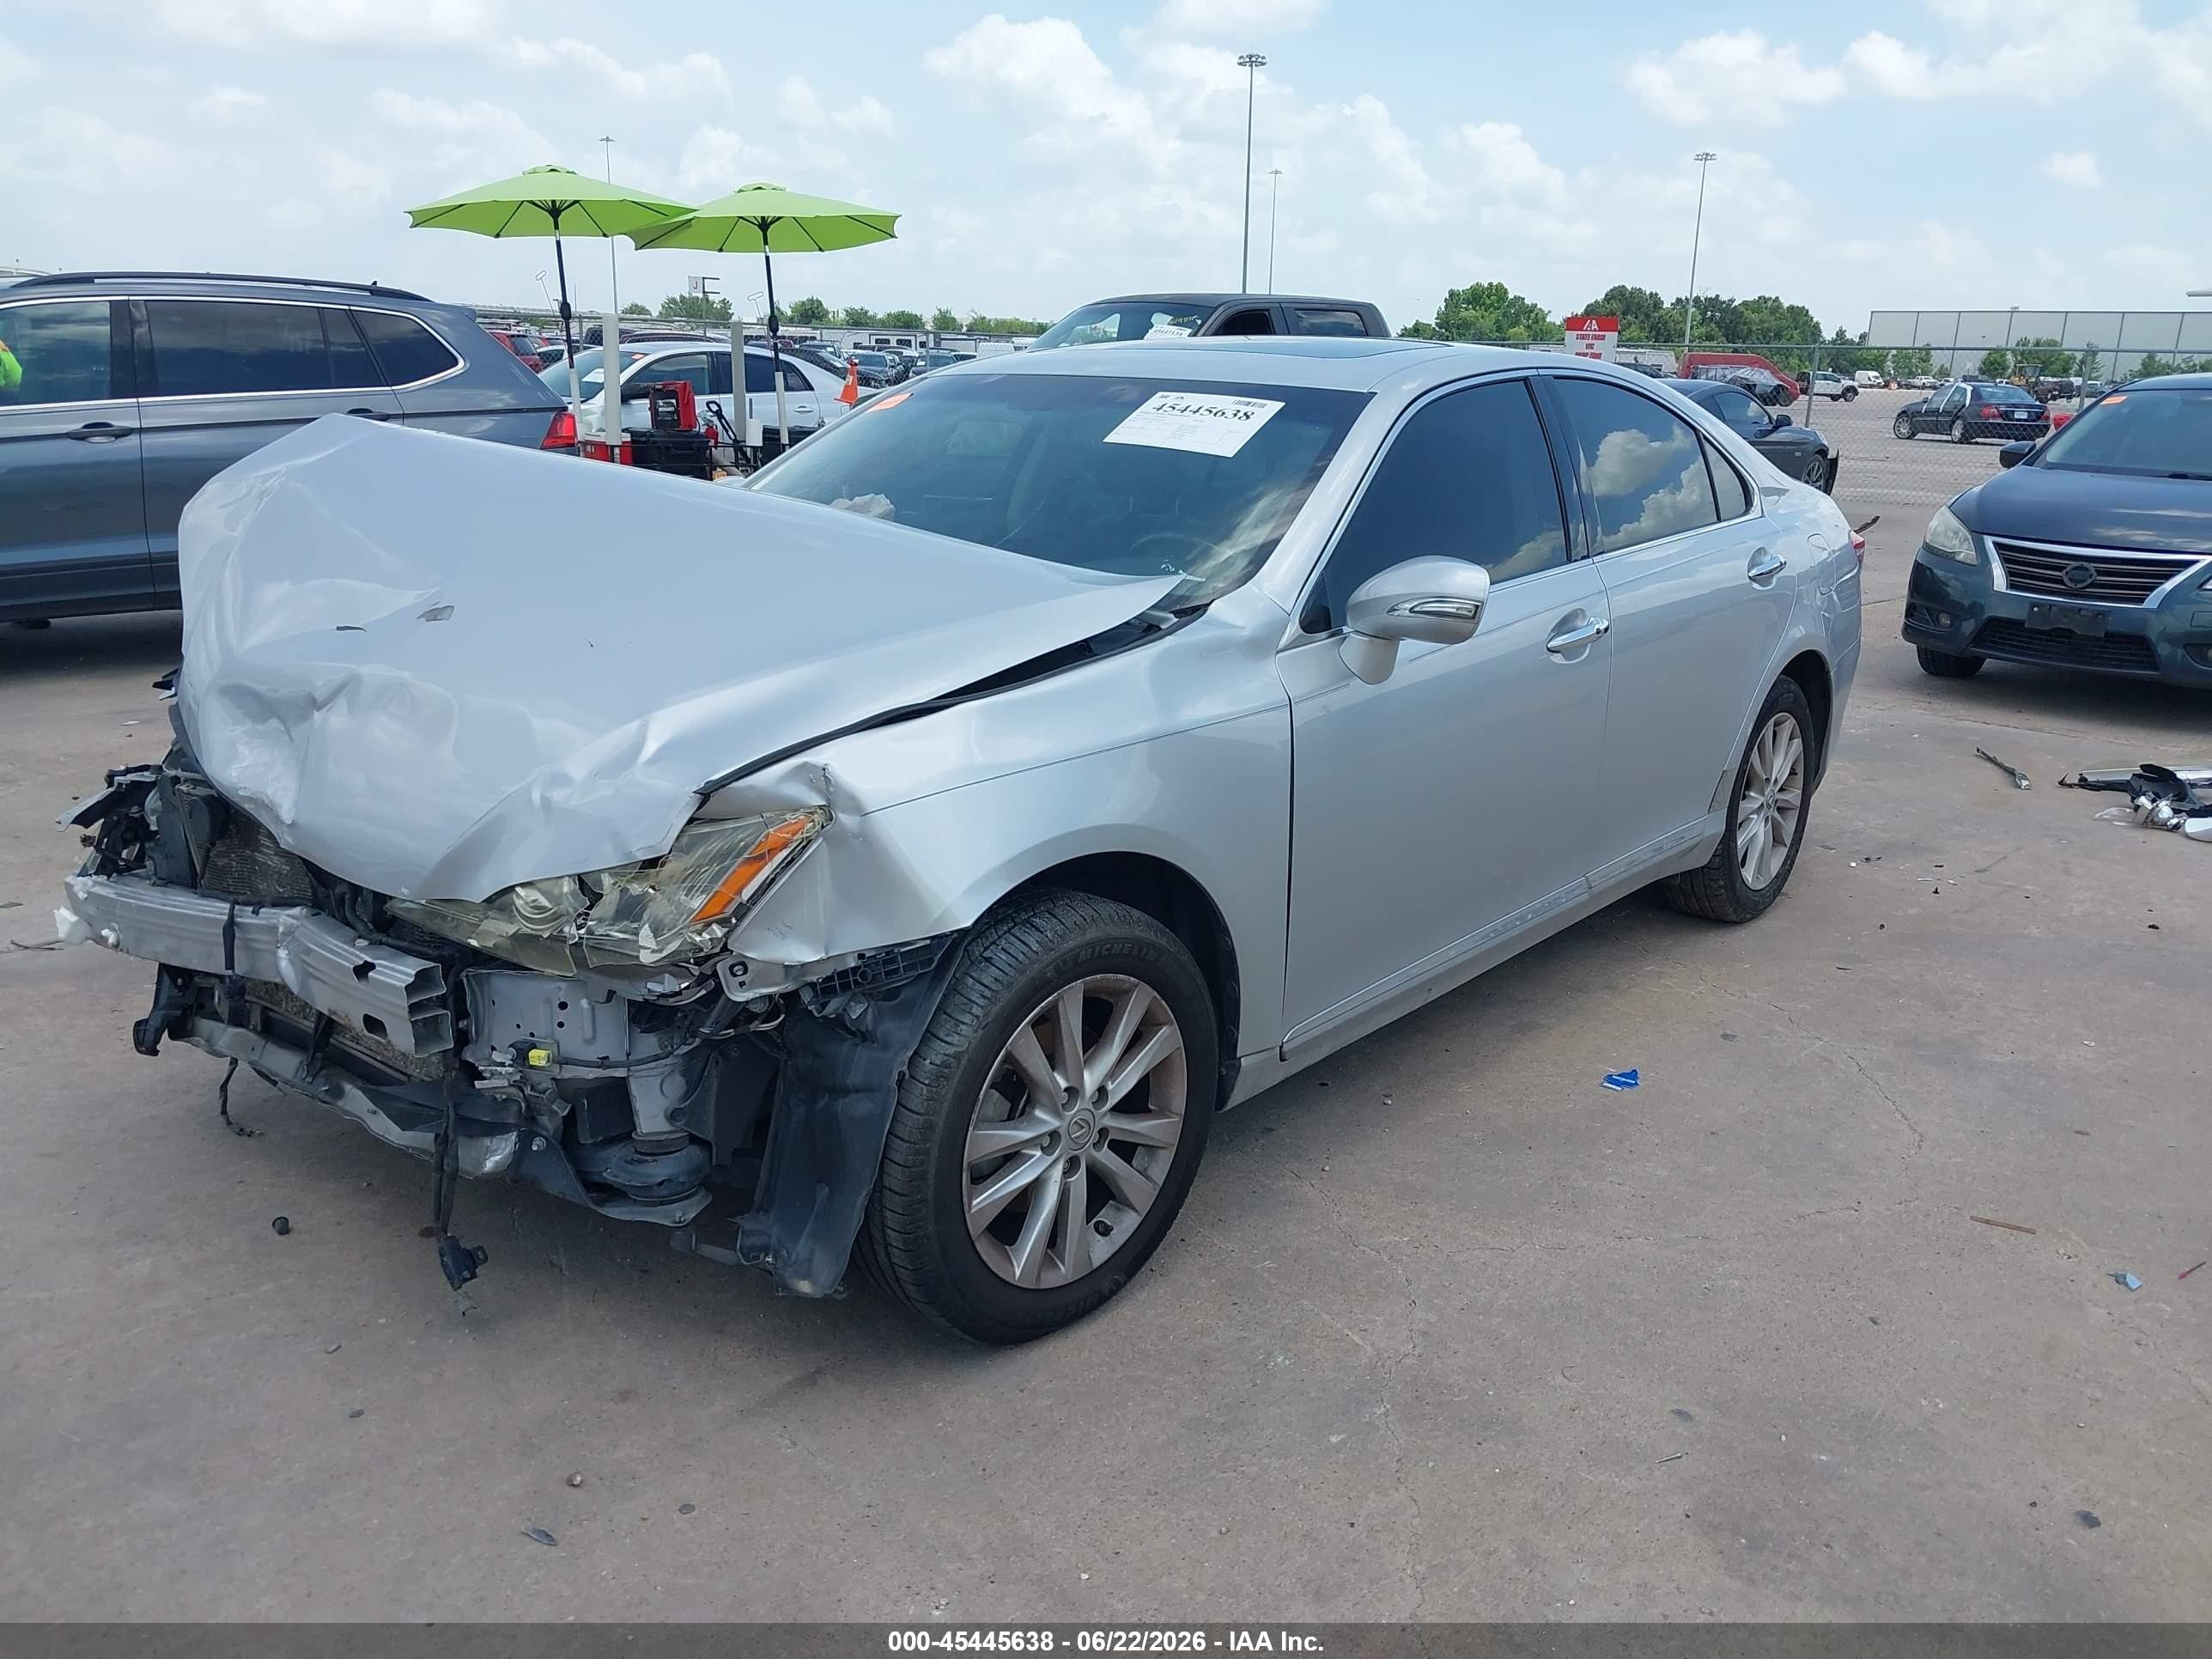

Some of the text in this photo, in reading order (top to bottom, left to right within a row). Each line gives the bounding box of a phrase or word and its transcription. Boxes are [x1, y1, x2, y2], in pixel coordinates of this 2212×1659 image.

[692, 281, 698, 289] J
[1152, 403, 1255, 422] 45445638
[1079, 943, 1156, 963] MICHELIN
